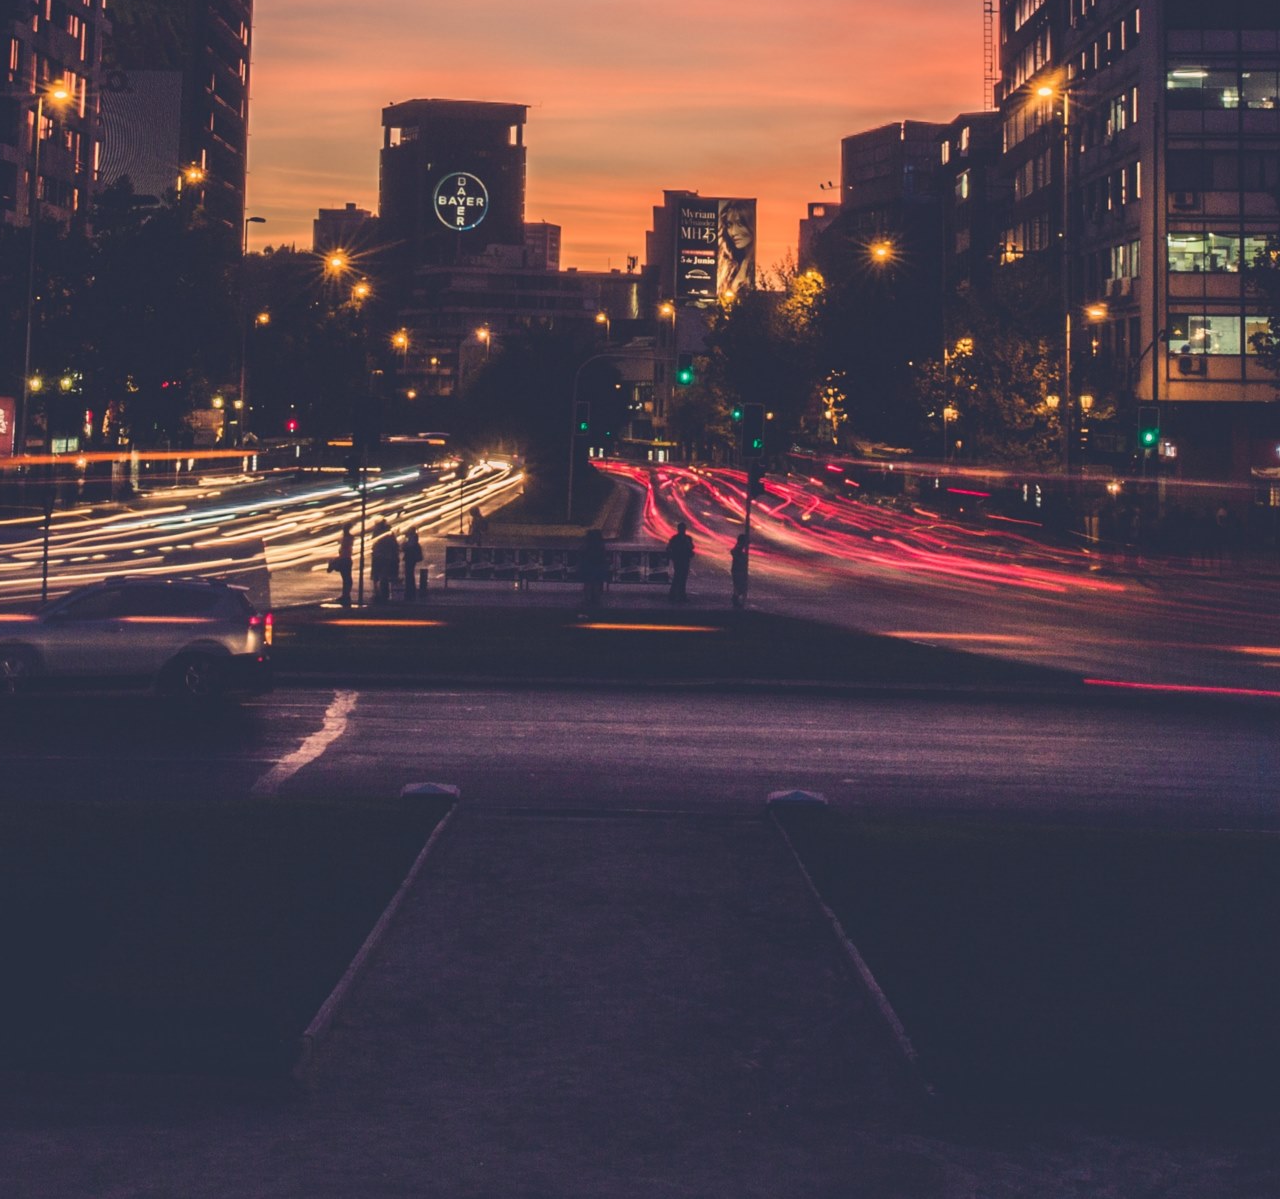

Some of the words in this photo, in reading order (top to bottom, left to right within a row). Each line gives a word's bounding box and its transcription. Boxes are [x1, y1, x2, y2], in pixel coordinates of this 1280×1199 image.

[438, 195, 484, 207] BAYER
[681, 208, 716, 220] Myriam
[680, 255, 686, 264] 5
[693, 255, 716, 265] Junio
